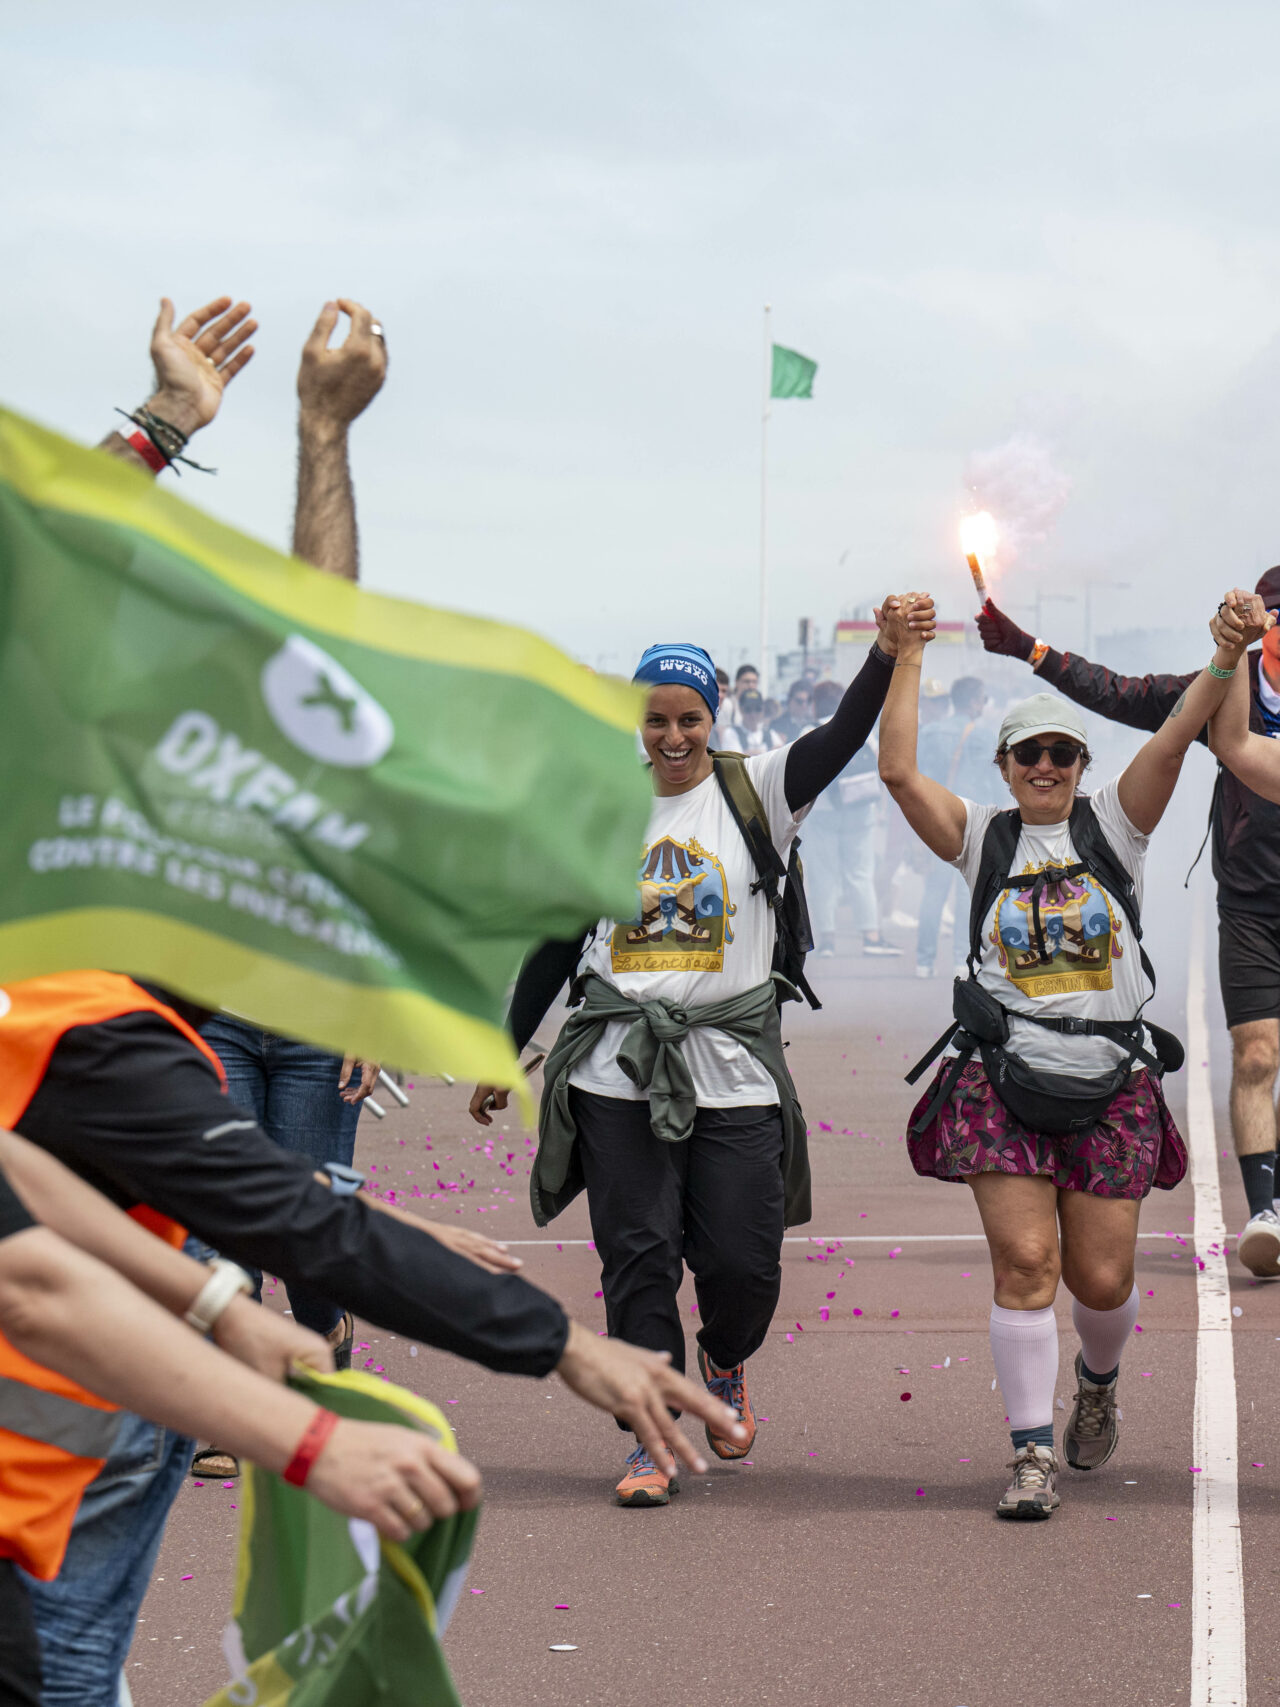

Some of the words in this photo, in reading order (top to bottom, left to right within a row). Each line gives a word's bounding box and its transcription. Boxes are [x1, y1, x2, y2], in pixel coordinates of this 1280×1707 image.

[660, 662, 708, 686] OXFAM
[154, 709, 370, 851] OXFAM
[614, 956, 641, 971] Les
